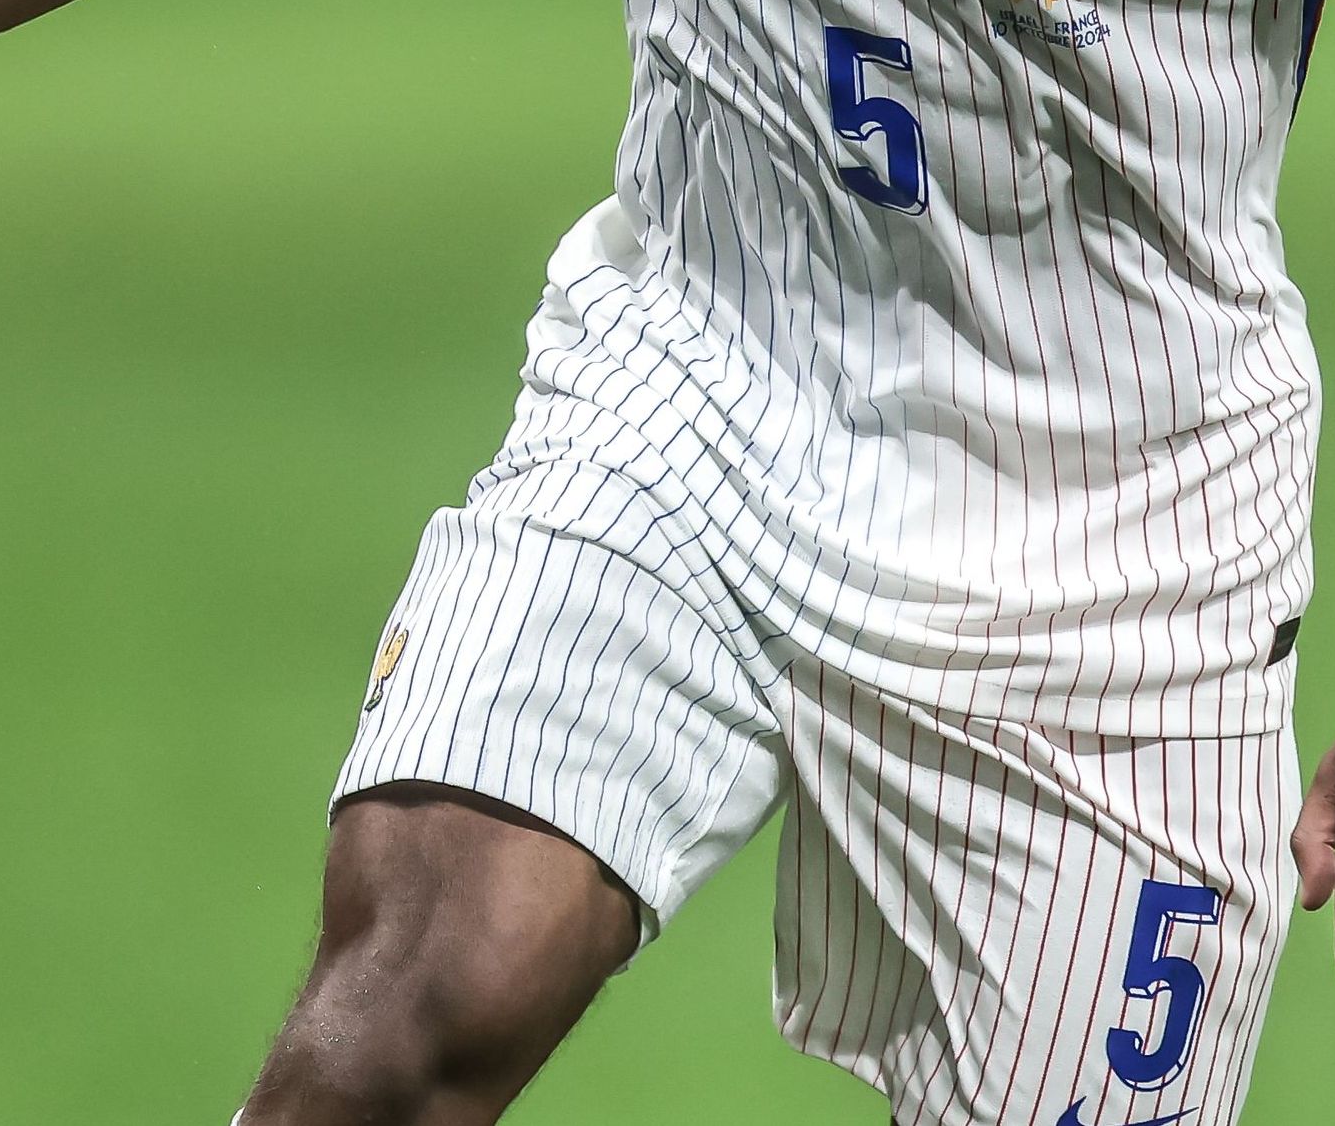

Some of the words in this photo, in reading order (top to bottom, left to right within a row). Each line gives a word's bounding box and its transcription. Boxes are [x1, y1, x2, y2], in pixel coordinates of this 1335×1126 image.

[992, 21, 1007, 39] 10
[1076, 24, 1111, 48] 2024
[1054, 8, 1100, 34] FRANCE
[825, 26, 928, 216] 5
[1106, 879, 1222, 1092] 5
